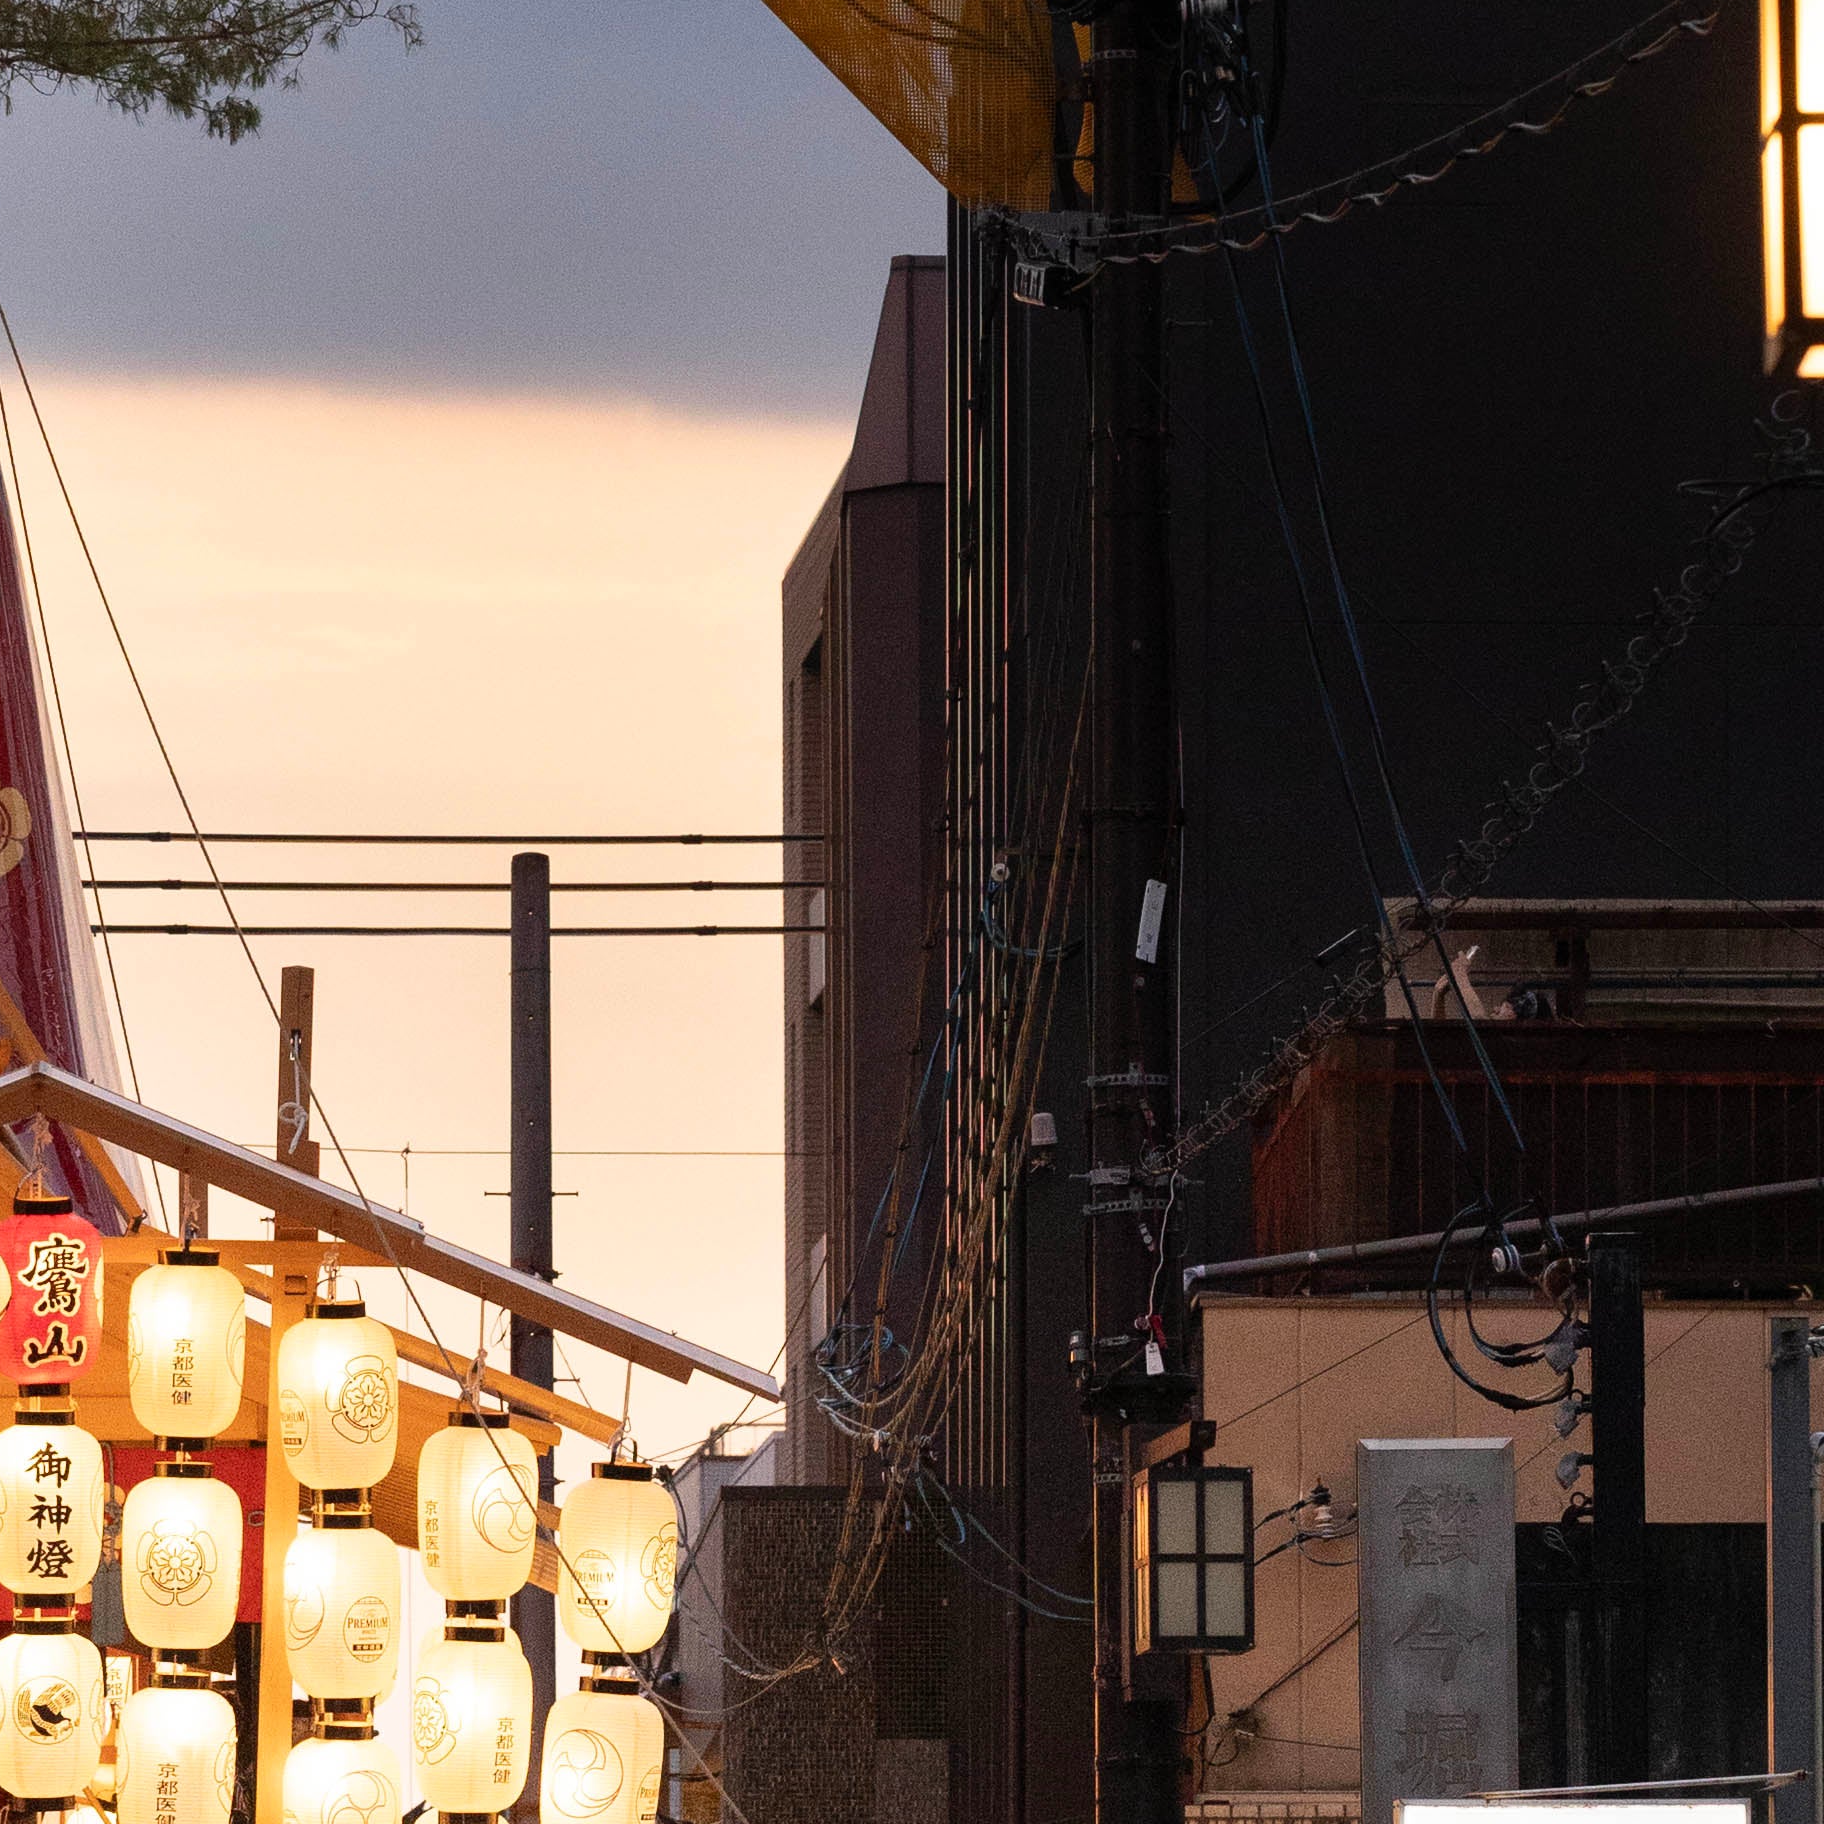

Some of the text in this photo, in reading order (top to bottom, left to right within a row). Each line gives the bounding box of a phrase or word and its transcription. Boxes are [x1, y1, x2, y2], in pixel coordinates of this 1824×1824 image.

[172, 1338, 194, 1406] 京都医健
[25, 1442, 74, 1579] 御神燈
[347, 1617, 388, 1629] PREMIUM
[492, 1717, 514, 1785] 京都医健
